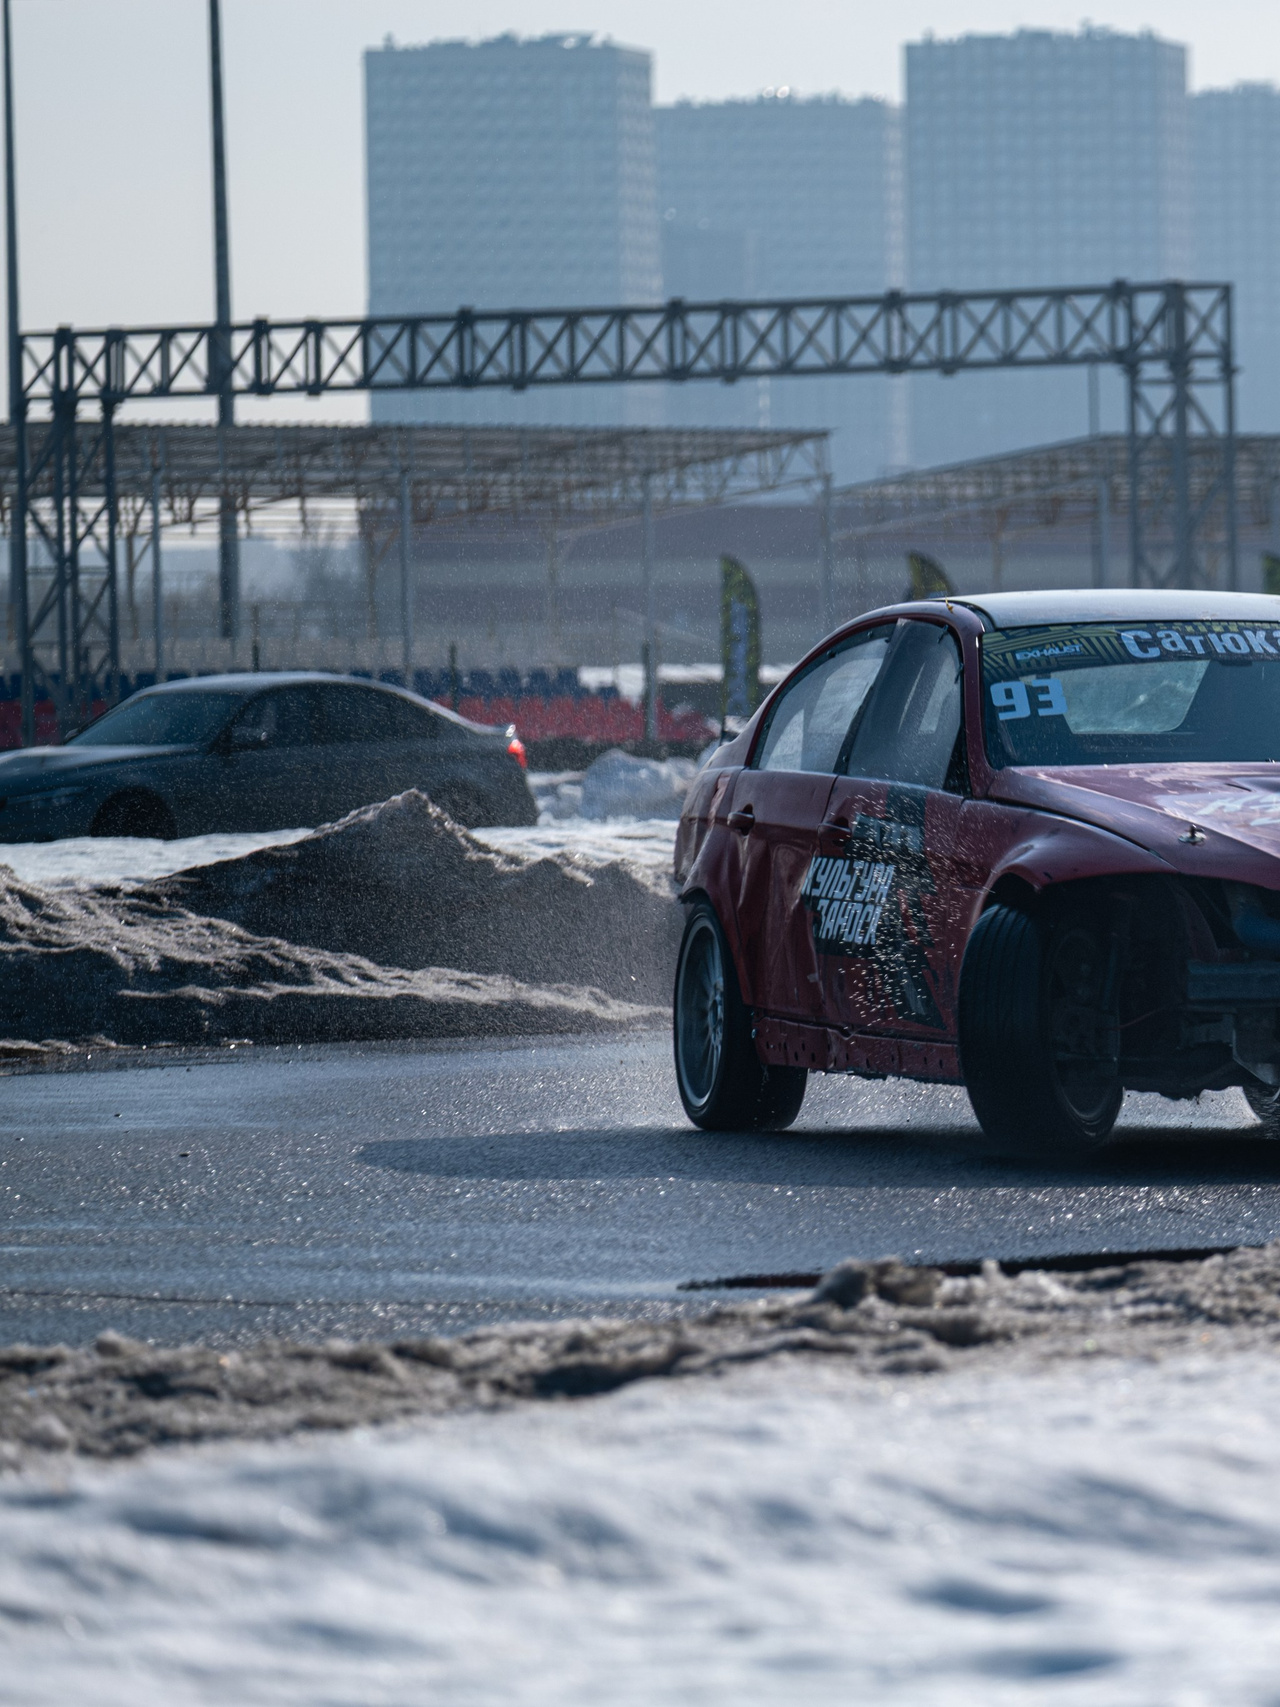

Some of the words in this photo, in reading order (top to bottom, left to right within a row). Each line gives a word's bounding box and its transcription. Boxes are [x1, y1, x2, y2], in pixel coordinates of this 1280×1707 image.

[1016, 644, 1083, 660] EXHAUST
[989, 678, 1068, 720] 93
[801, 856, 896, 904] КУЛЬТУРА
[817, 899, 884, 946] ЗАНОСА
